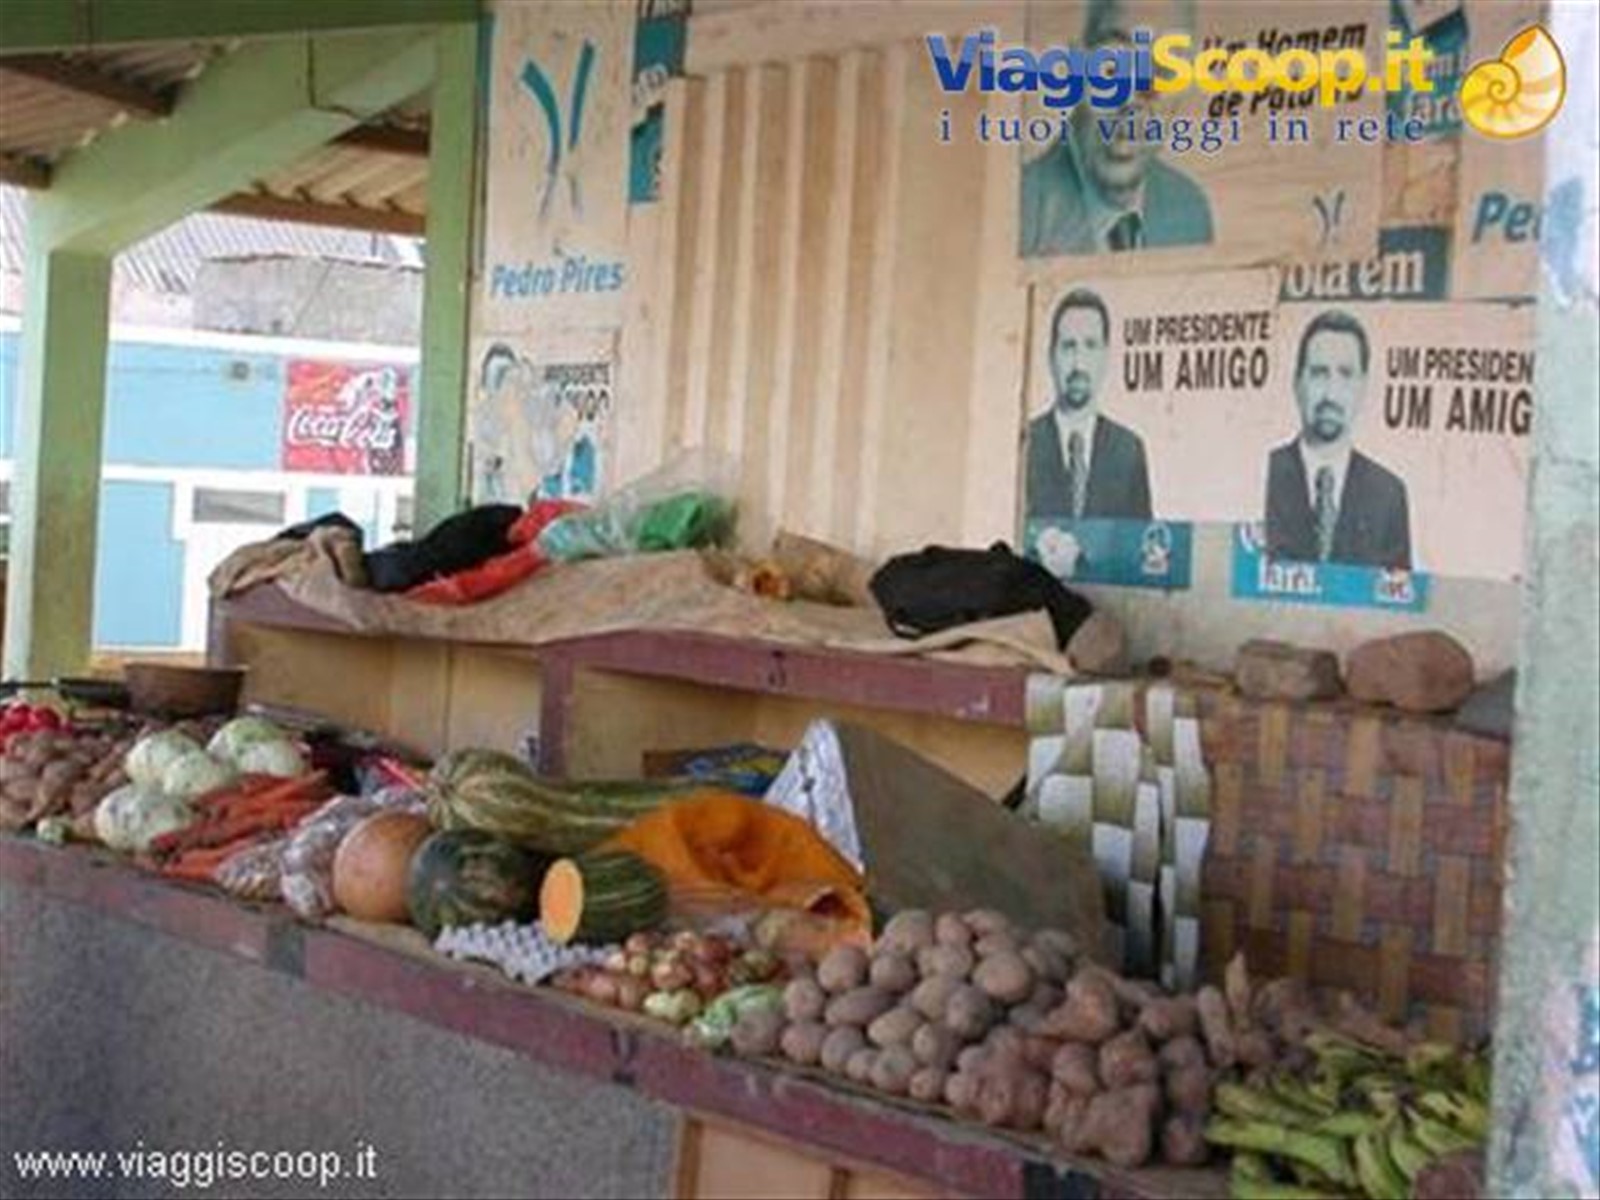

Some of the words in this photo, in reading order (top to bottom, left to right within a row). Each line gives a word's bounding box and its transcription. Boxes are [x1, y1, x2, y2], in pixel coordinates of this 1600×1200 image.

[1471, 191, 1541, 244] Pe
[491, 261, 556, 298] Pedro
[559, 254, 624, 293] Pires
[1358, 252, 1425, 297] em
[1124, 317, 1152, 346] UM
[1155, 310, 1271, 345] PRESIDENTE
[1124, 349, 1163, 391] UM
[1175, 345, 1269, 390] AMIGO
[1387, 347, 1421, 378] UM
[1424, 348, 1535, 384] PRESIDEN
[1384, 384, 1432, 429] UM
[1445, 387, 1533, 437] AMIG
